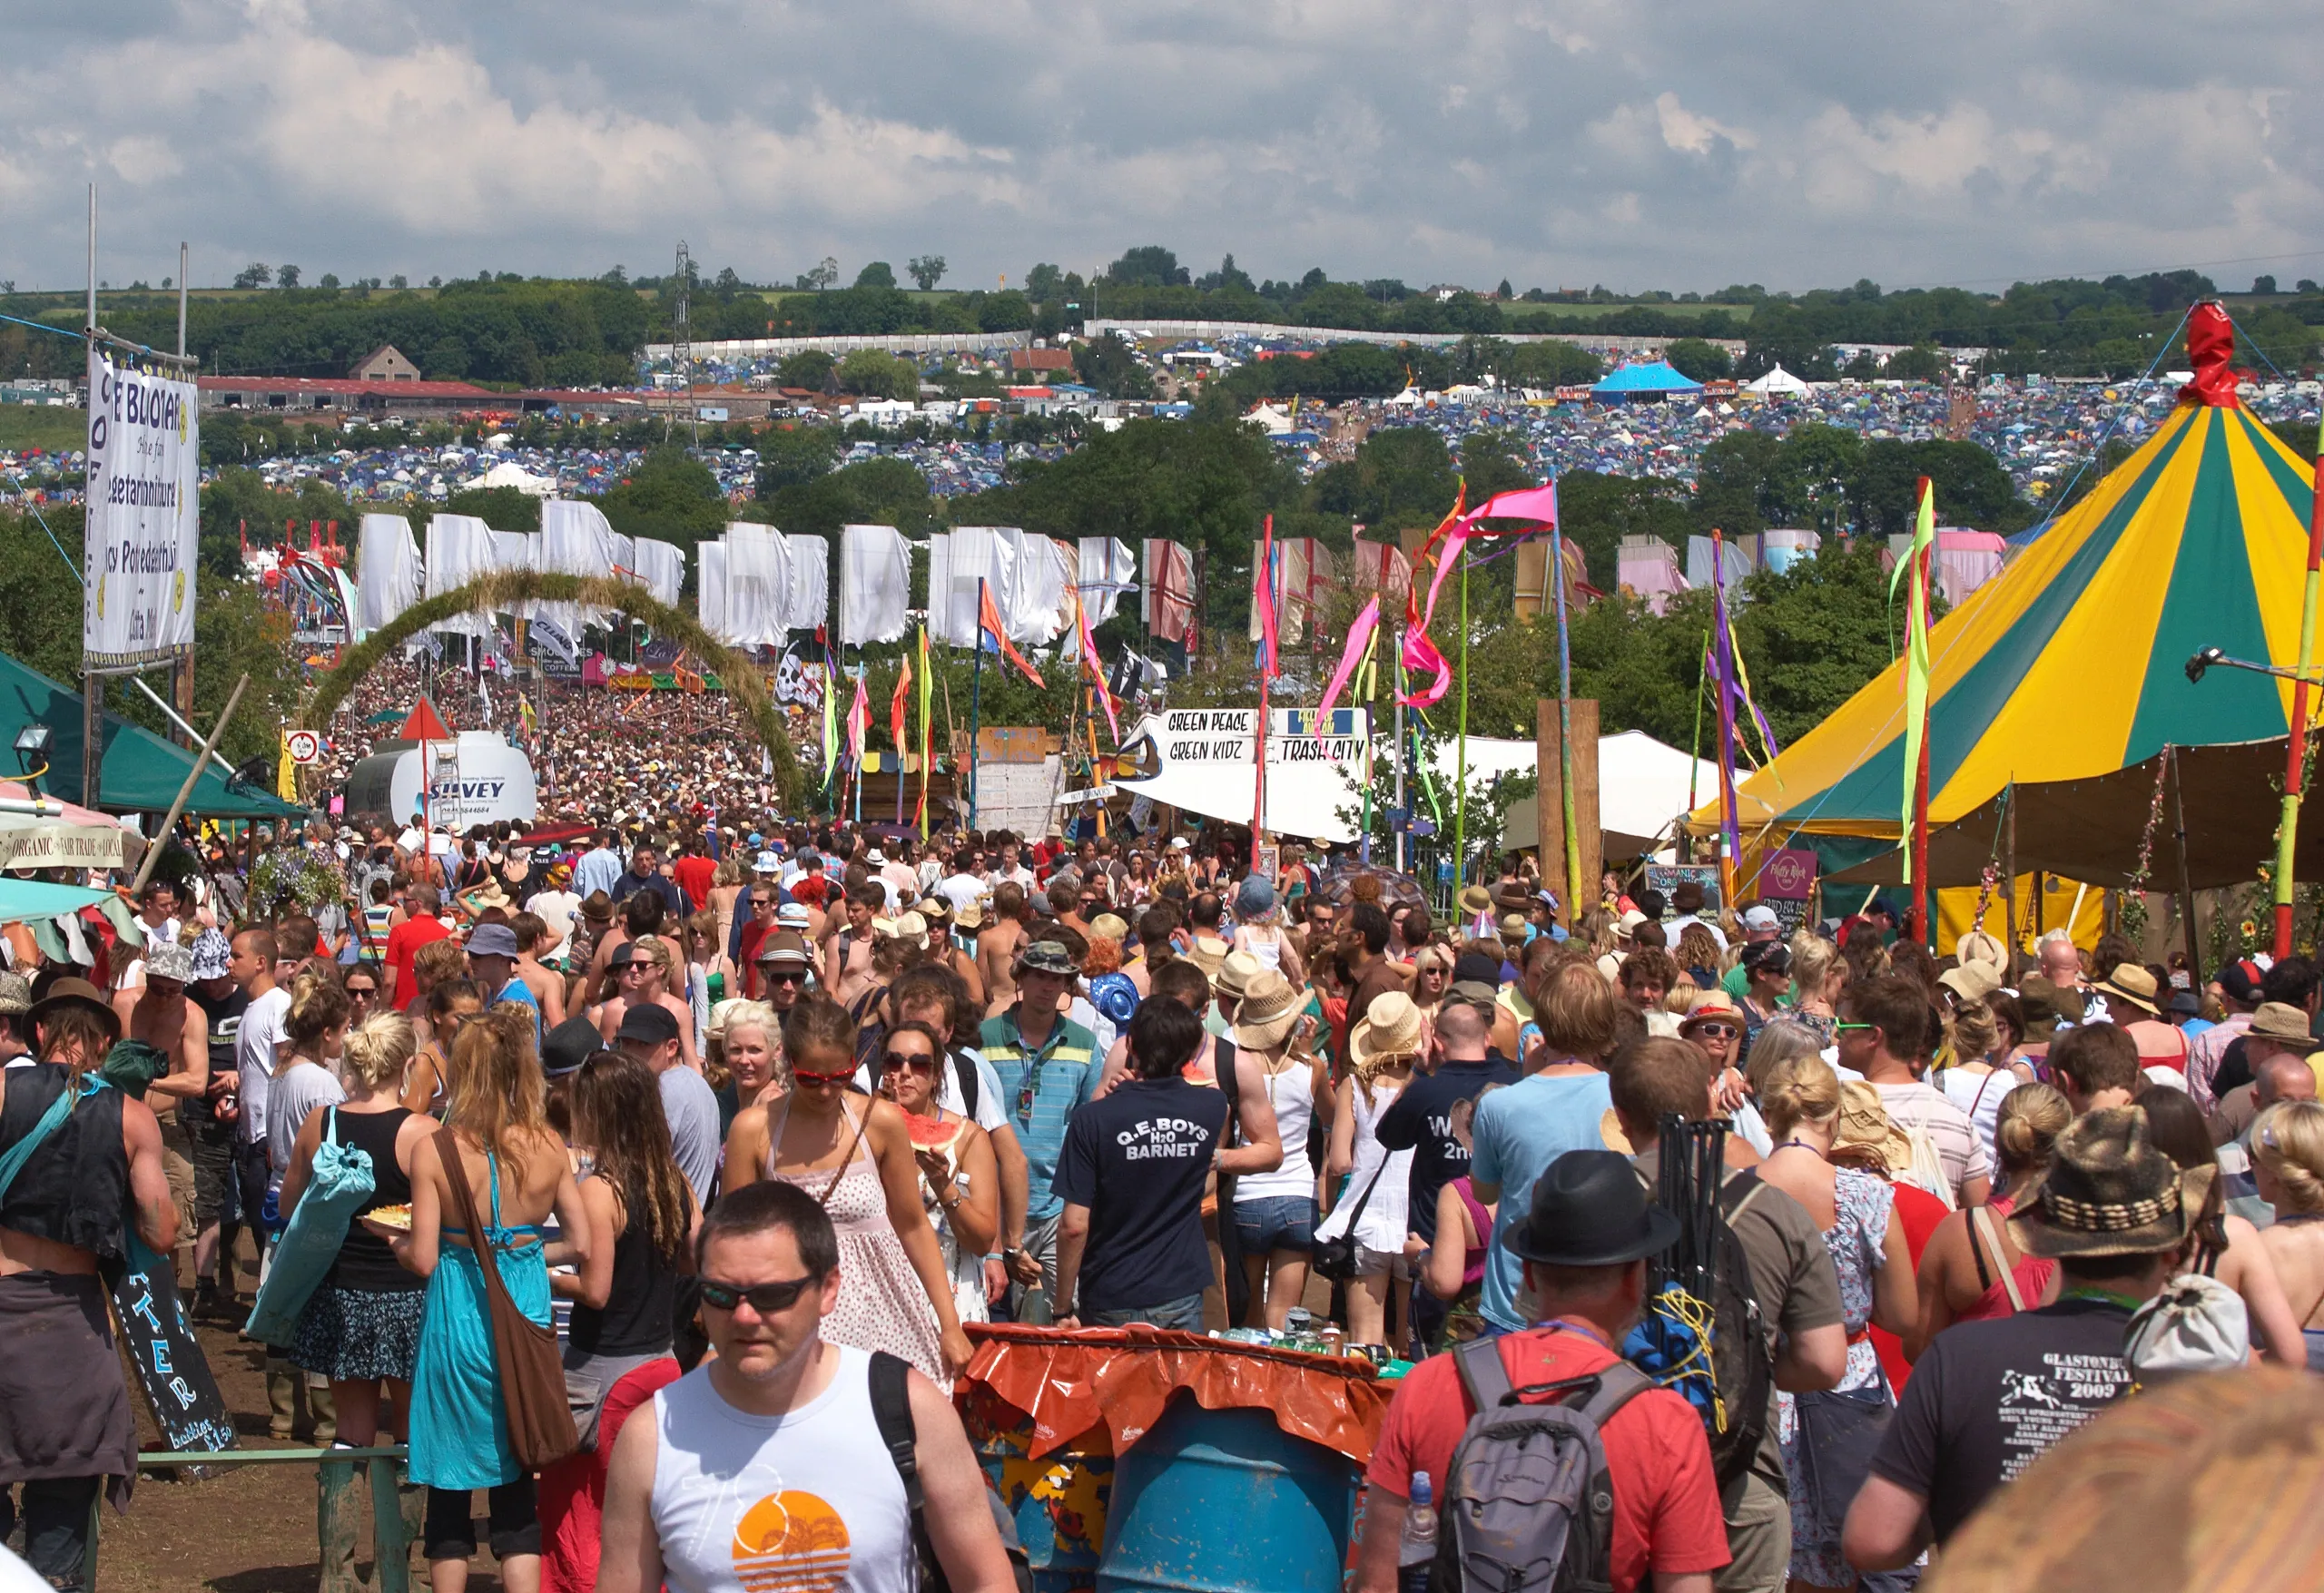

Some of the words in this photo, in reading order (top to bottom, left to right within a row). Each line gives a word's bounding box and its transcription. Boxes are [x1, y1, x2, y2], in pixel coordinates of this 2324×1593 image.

[1168, 713, 1207, 732] GREEN
[1211, 713, 1249, 732] PEACE
[1303, 721, 1335, 734] AVON
[1169, 741, 1208, 761] GREEN
[1212, 741, 1243, 760] KIDZ
[1282, 740, 1329, 761] TRASH
[1332, 740, 1365, 761] CITY
[12, 836, 54, 858] ORGANIC
[60, 837, 74, 857] FAIR
[76, 838, 96, 857] TRADE
[103, 837, 123, 857] LOCAL
[1150, 1130, 1176, 1144] H2O
[1126, 1142, 1199, 1160] BARNET
[1444, 1142, 1472, 1160] 2n
[2055, 1367, 2132, 1382] FESTIVAL
[2070, 1382, 2116, 1399] 2009
